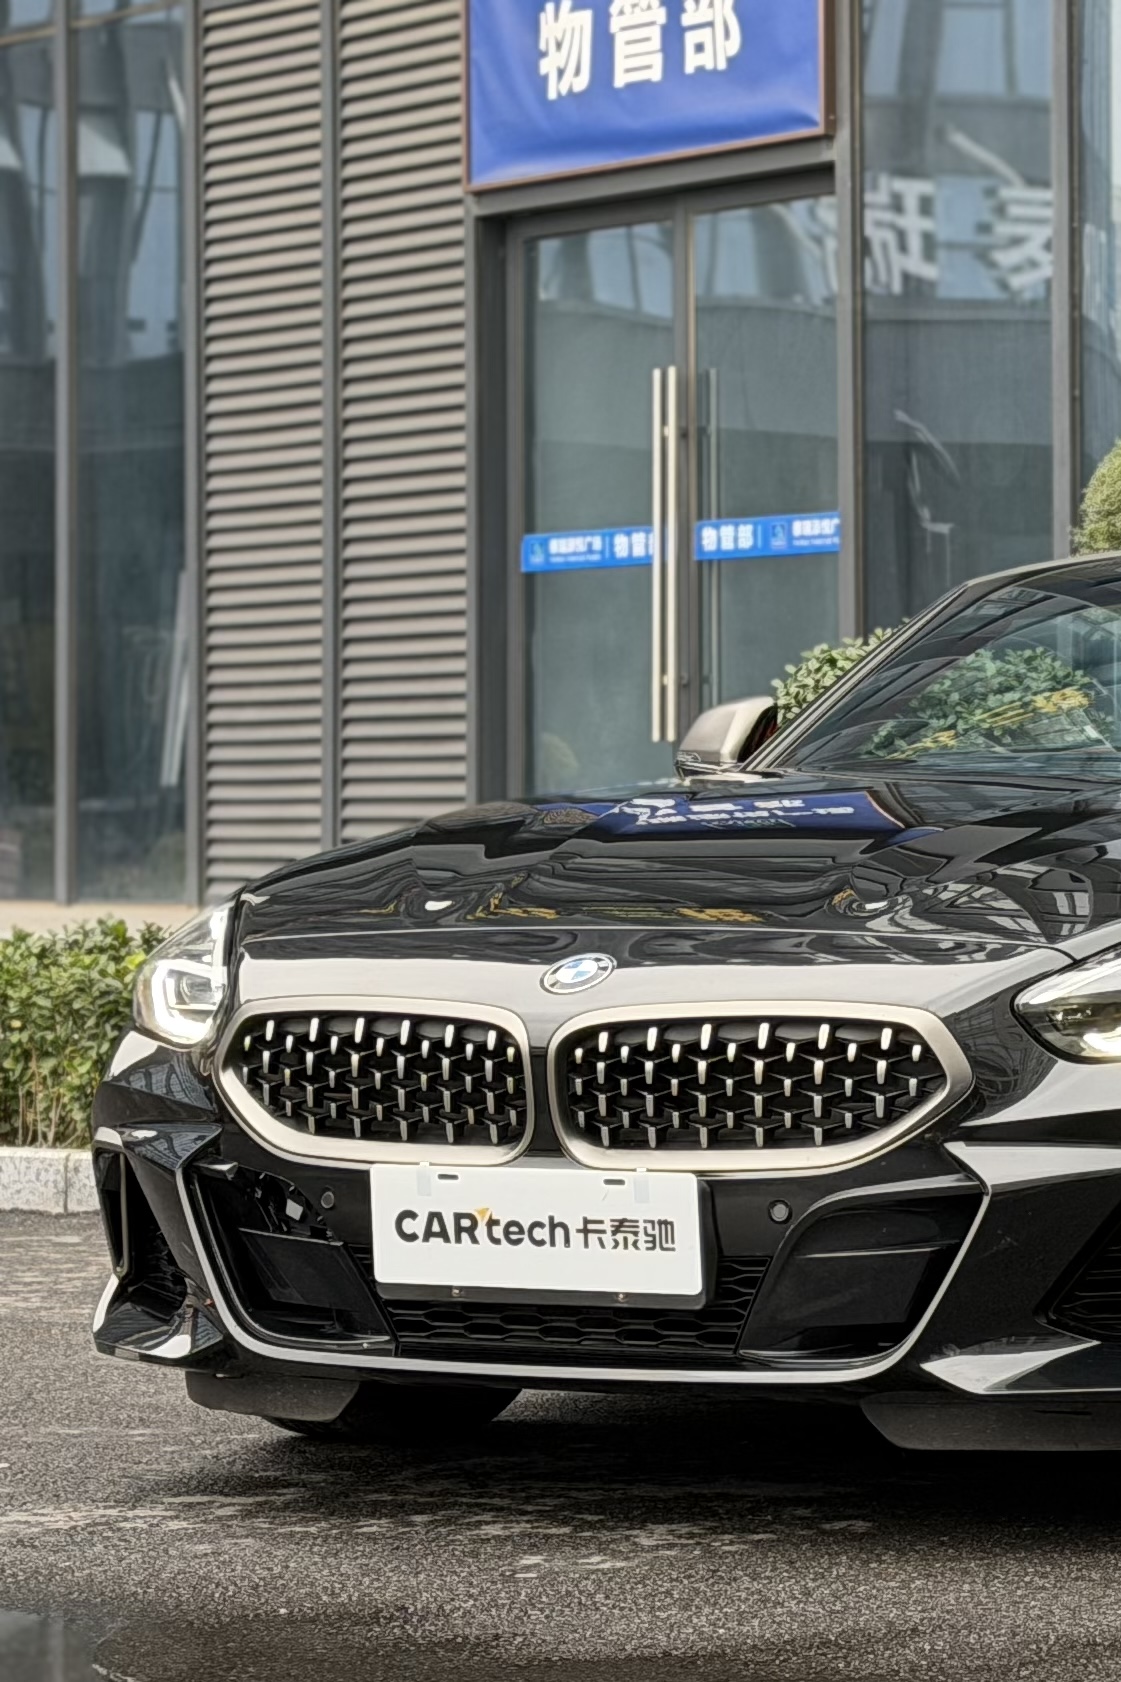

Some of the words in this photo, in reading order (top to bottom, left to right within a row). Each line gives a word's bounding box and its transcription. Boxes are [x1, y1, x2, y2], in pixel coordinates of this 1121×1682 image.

[539, 0, 742, 100] 物管部
[613, 532, 653, 558] 物管
[394, 1208, 571, 1248] CARtech
[576, 1215, 676, 1252] 卡泰驰
